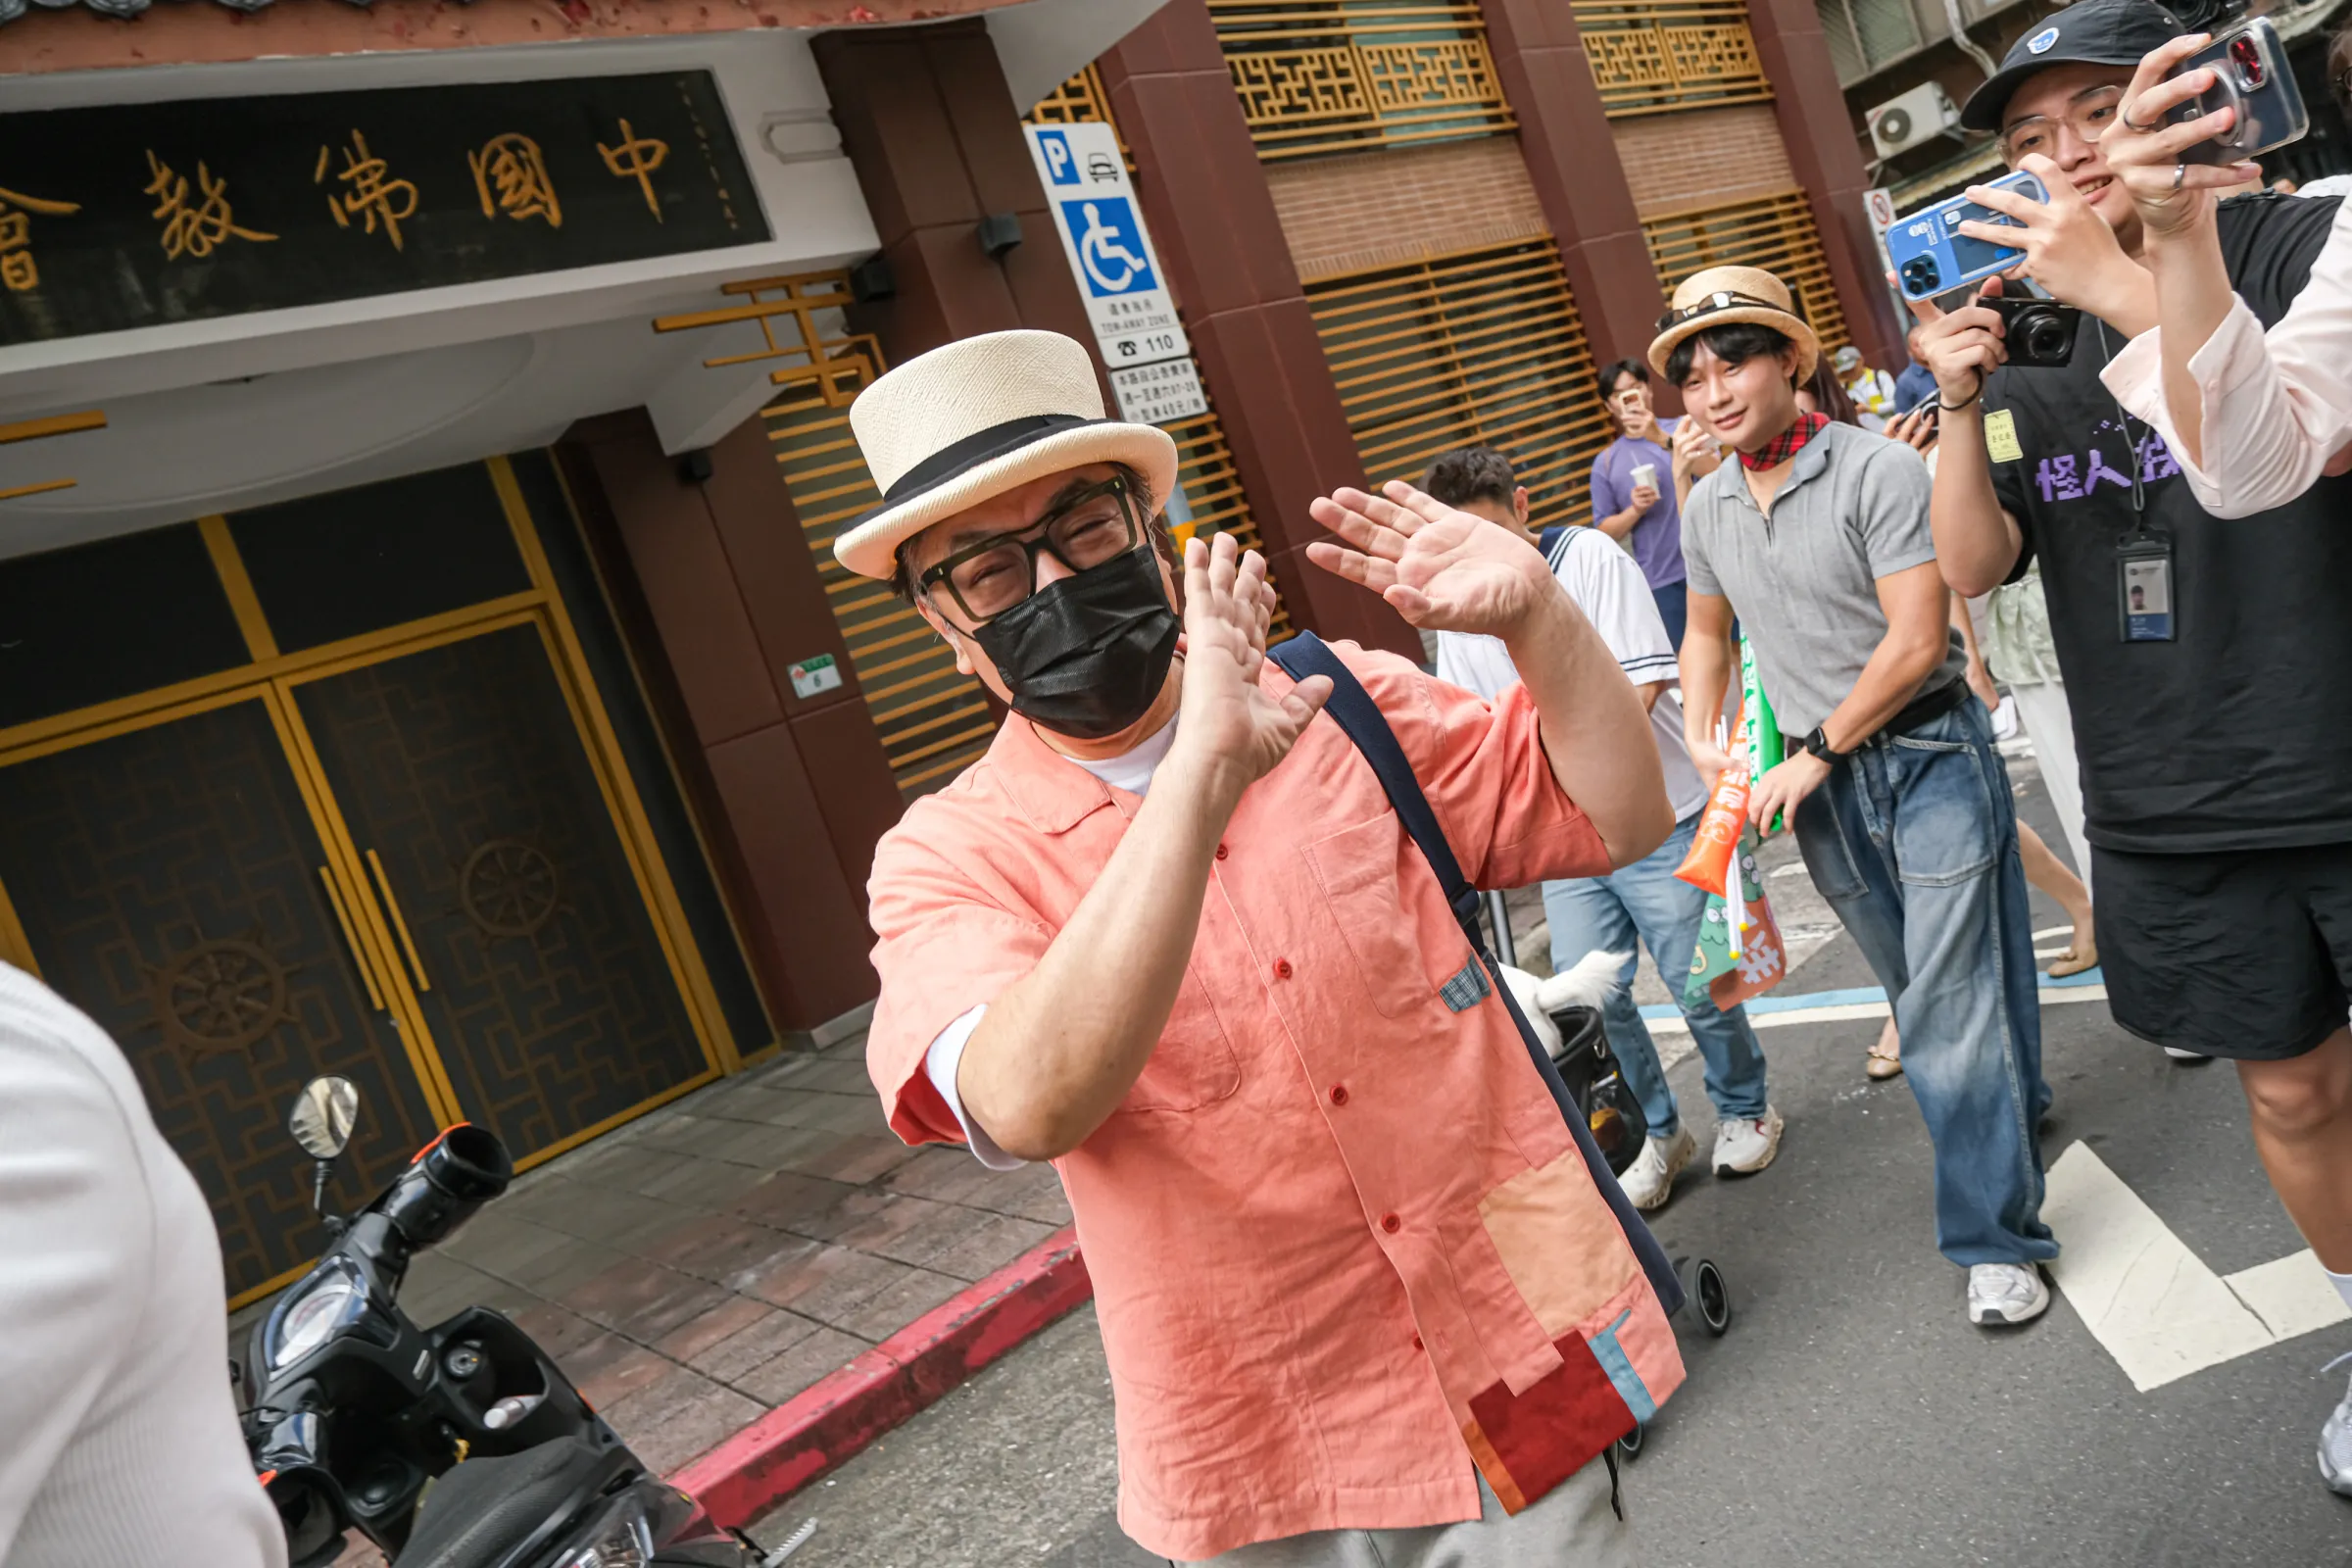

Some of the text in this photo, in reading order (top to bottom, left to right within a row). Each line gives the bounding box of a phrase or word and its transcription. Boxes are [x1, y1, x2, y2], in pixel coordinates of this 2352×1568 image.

[1042, 138, 1068, 178] P
[1148, 313, 1170, 326] ZONE
[1147, 334, 1174, 352] 110
